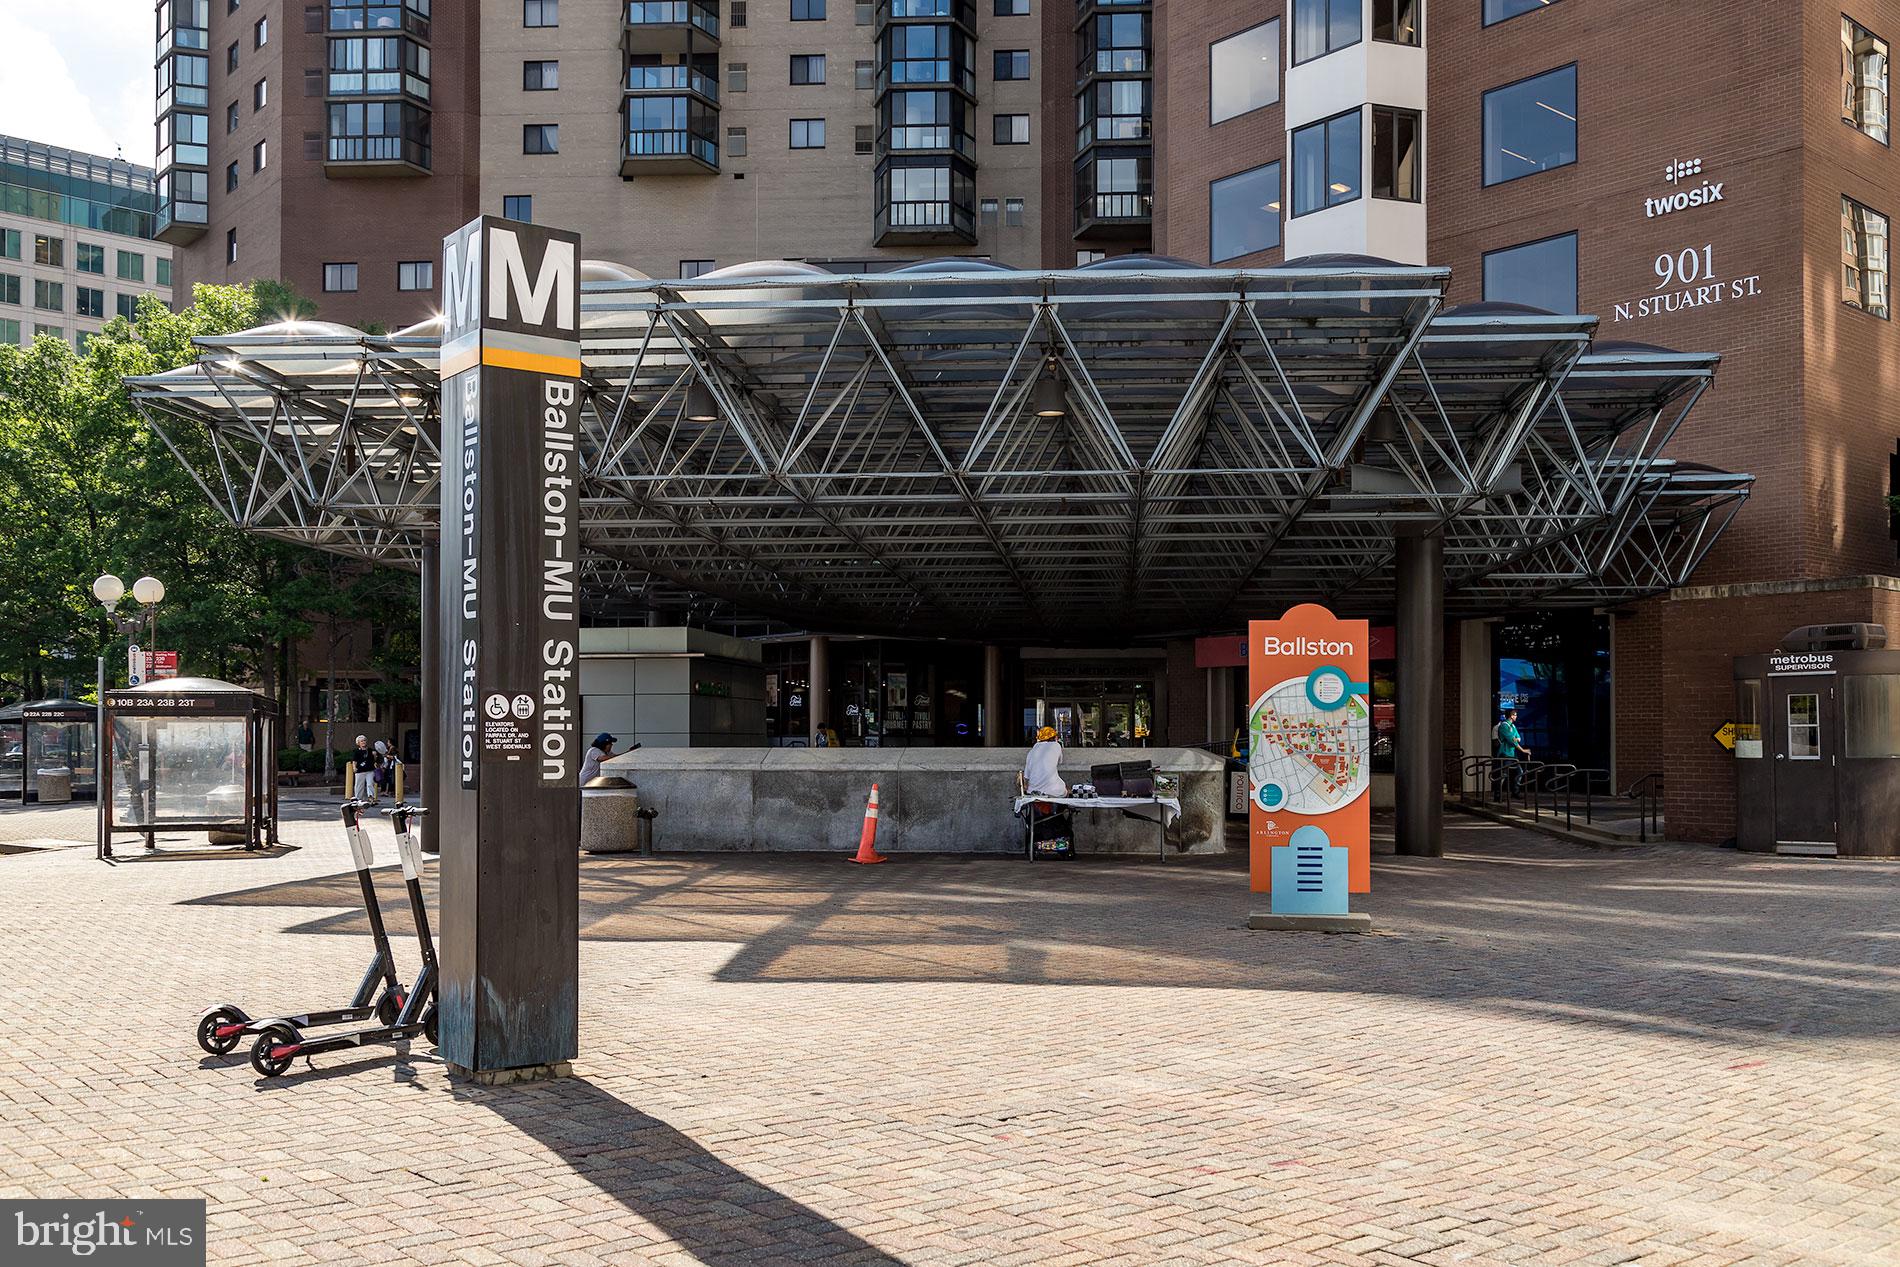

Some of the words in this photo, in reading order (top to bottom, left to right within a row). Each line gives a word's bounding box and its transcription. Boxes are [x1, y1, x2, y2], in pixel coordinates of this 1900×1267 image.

[1644, 180, 1724, 218] twosix
[444, 229, 480, 334] M
[488, 227, 575, 331] M
[1654, 243, 1716, 290] 901
[1613, 302, 1634, 322] N.
[1638, 282, 1726, 317] STUART
[1731, 275, 1762, 299] ST.
[462, 373, 478, 620] Ballston-MU
[543, 379, 575, 621] Ballston-MU
[1264, 636, 1353, 656] Ballston
[1770, 653, 1834, 664] metrobus
[1775, 662, 1830, 671] SUPERVISOR
[116, 698, 134, 707] 10B
[136, 698, 154, 707] 23A
[157, 698, 175, 707] 23B
[178, 698, 195, 707] 23T
[462, 639, 477, 783] Station
[543, 639, 574, 781] Station
[1235, 774, 1244, 810] POLITICO
